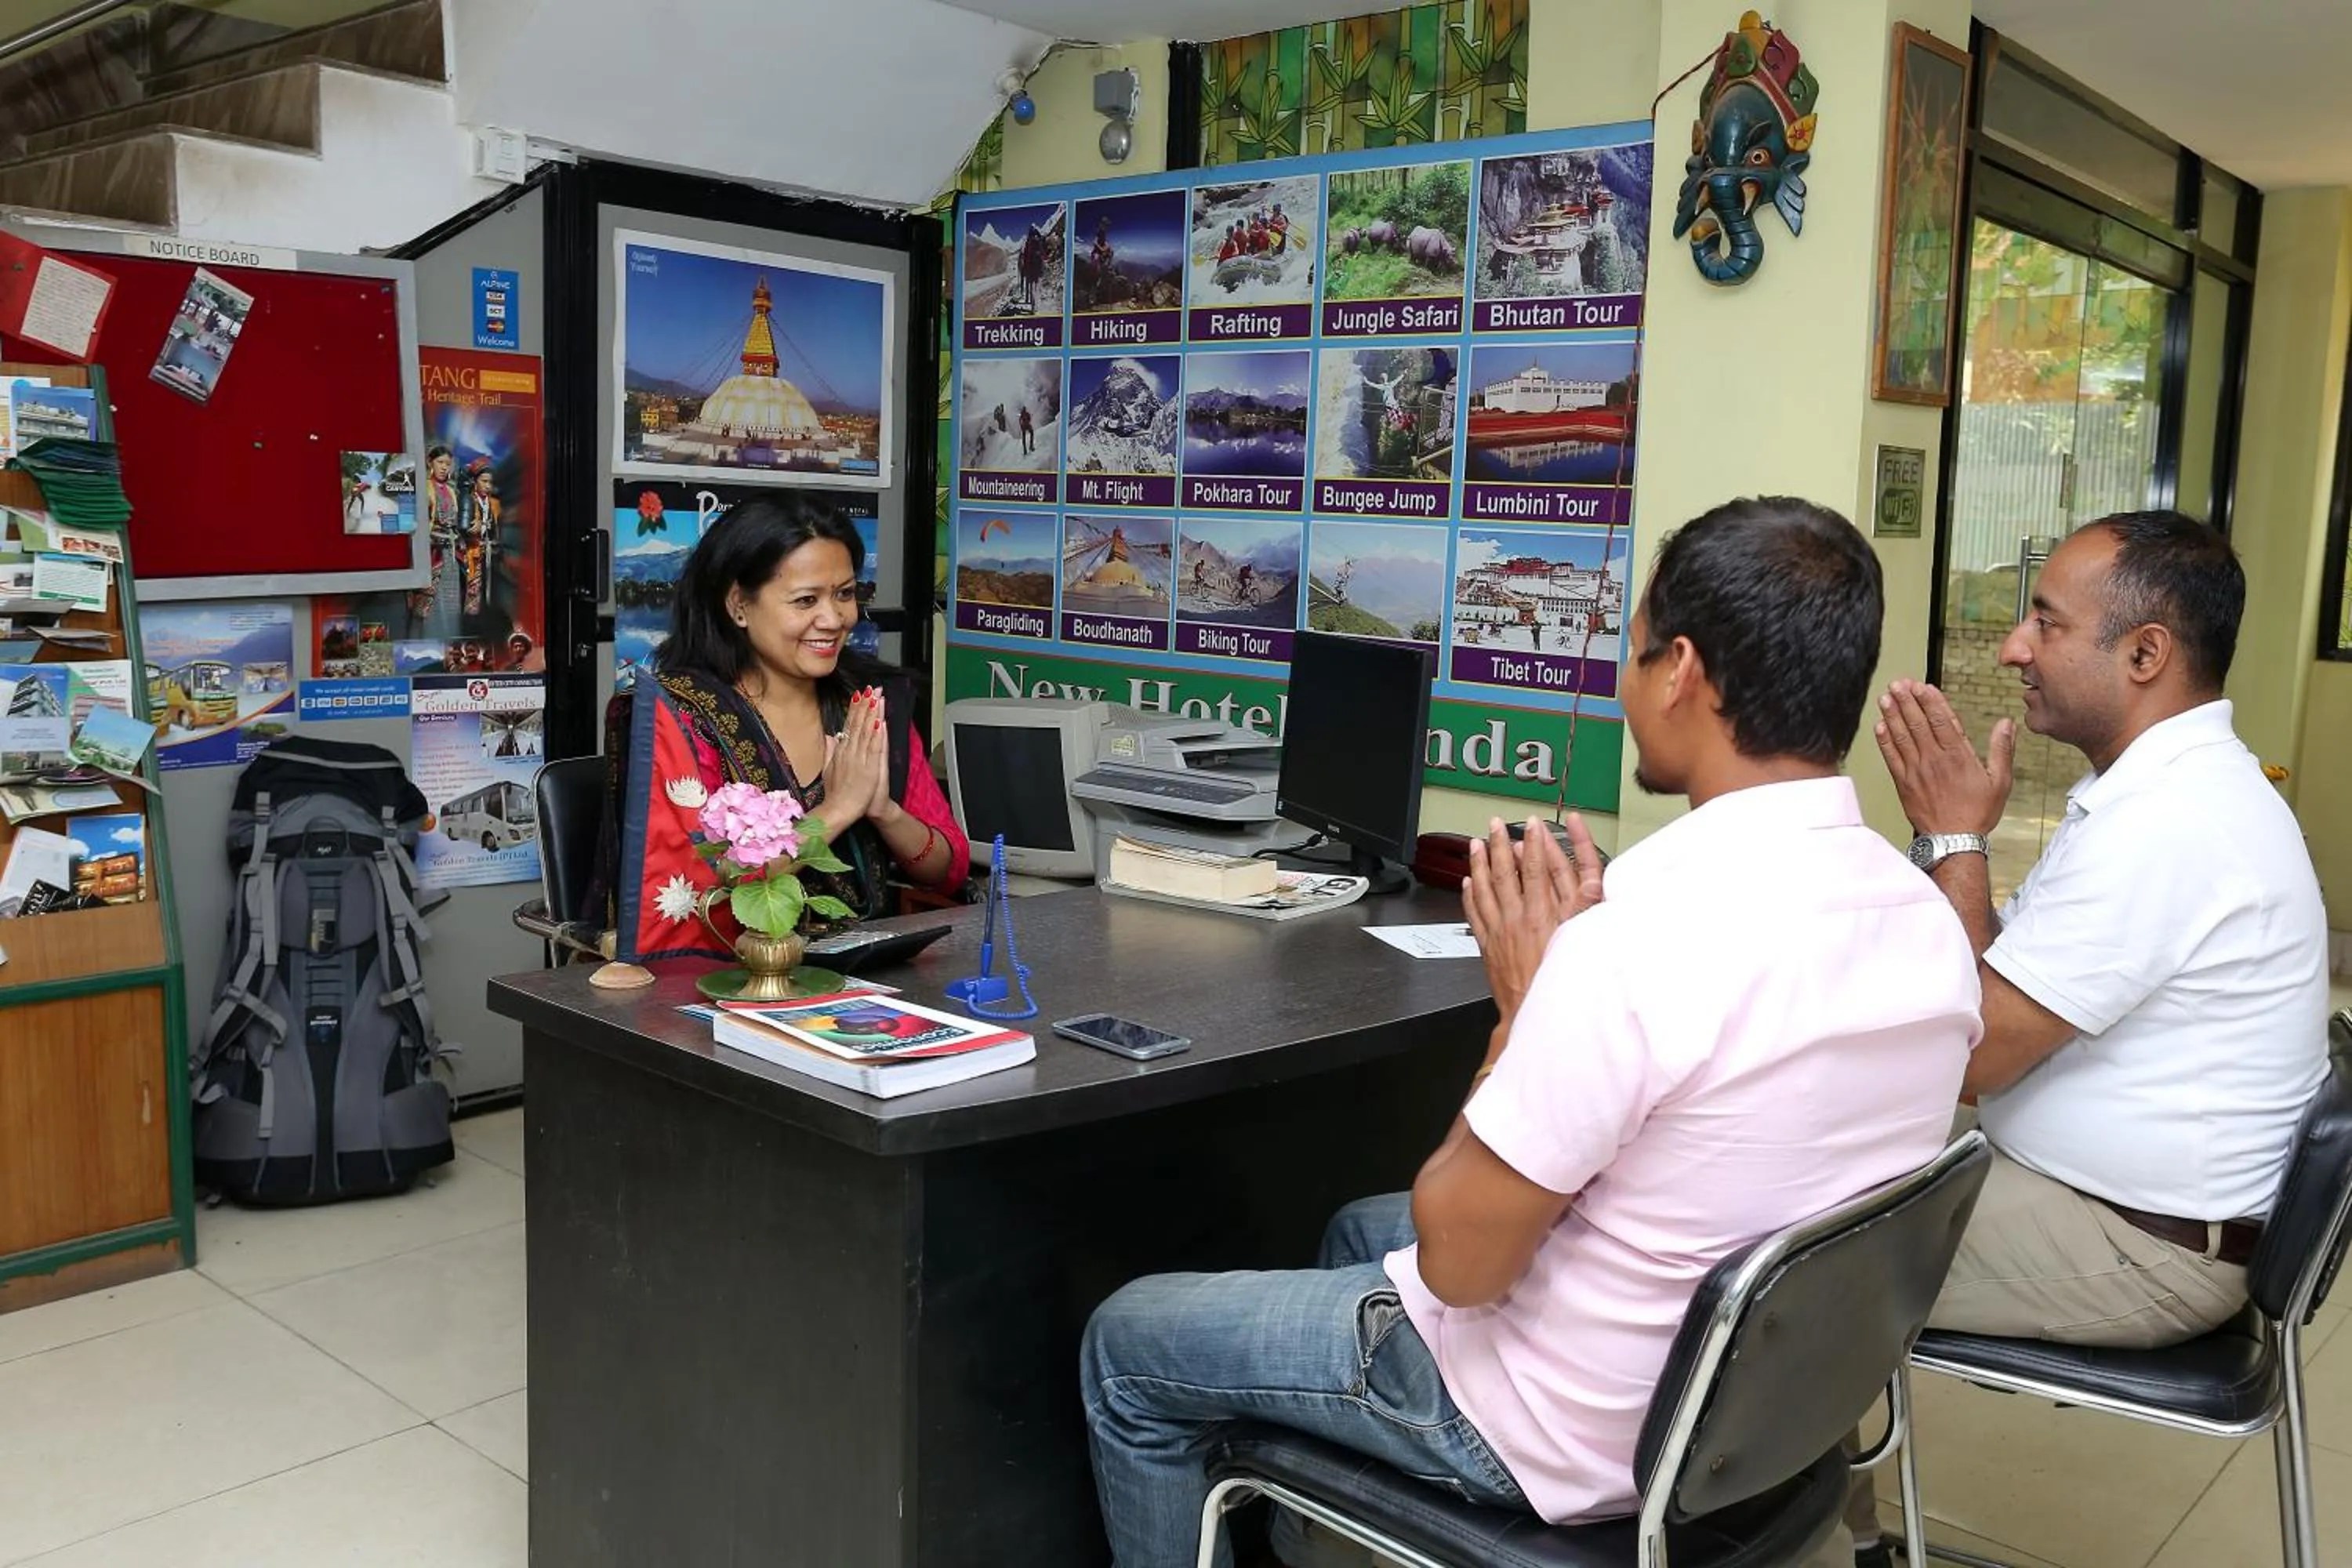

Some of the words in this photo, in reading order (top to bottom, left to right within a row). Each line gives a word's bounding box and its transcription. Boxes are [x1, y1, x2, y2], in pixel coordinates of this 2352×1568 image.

[150, 240, 205, 260] NOTICE
[209, 247, 260, 266] BOARD
[1210, 314, 1282, 337] Rafting
[1332, 308, 1395, 334] Jungle
[1401, 304, 1458, 328] Safari
[1490, 303, 1565, 327] Bhutan
[1573, 300, 1624, 324] Tour
[477, 334, 515, 347] Welcome
[975, 324, 1044, 346] Trekking
[1090, 319, 1148, 342] Hiking
[419, 365, 476, 390] TANG
[427, 388, 474, 408] Heritage
[479, 392, 502, 405] Trail
[1883, 459, 1919, 485] FREE
[967, 476, 1045, 502] Mountaineering
[1082, 480, 1102, 499] Mt.
[1105, 481, 1144, 504] Flight
[1193, 482, 1253, 504] Pokhara
[1258, 484, 1292, 505] Tour
[1323, 486, 1385, 512] Bungee
[1388, 488, 1436, 515] Jump
[1476, 491, 1550, 515] Lumbini
[1556, 493, 1599, 517] Tour
[977, 609, 1044, 637] Paragliding
[1073, 619, 1152, 644] Boudhanath
[1198, 630, 1238, 655] Biking
[1241, 633, 1271, 655] Tour
[1491, 656, 1530, 682] Tibet
[1534, 661, 1572, 686] Tour
[426, 697, 478, 713] Golden
[483, 697, 536, 710] Travels
[986, 661, 1106, 704] New
[1126, 677, 1288, 739] Hotel
[1424, 717, 1557, 785] nda
